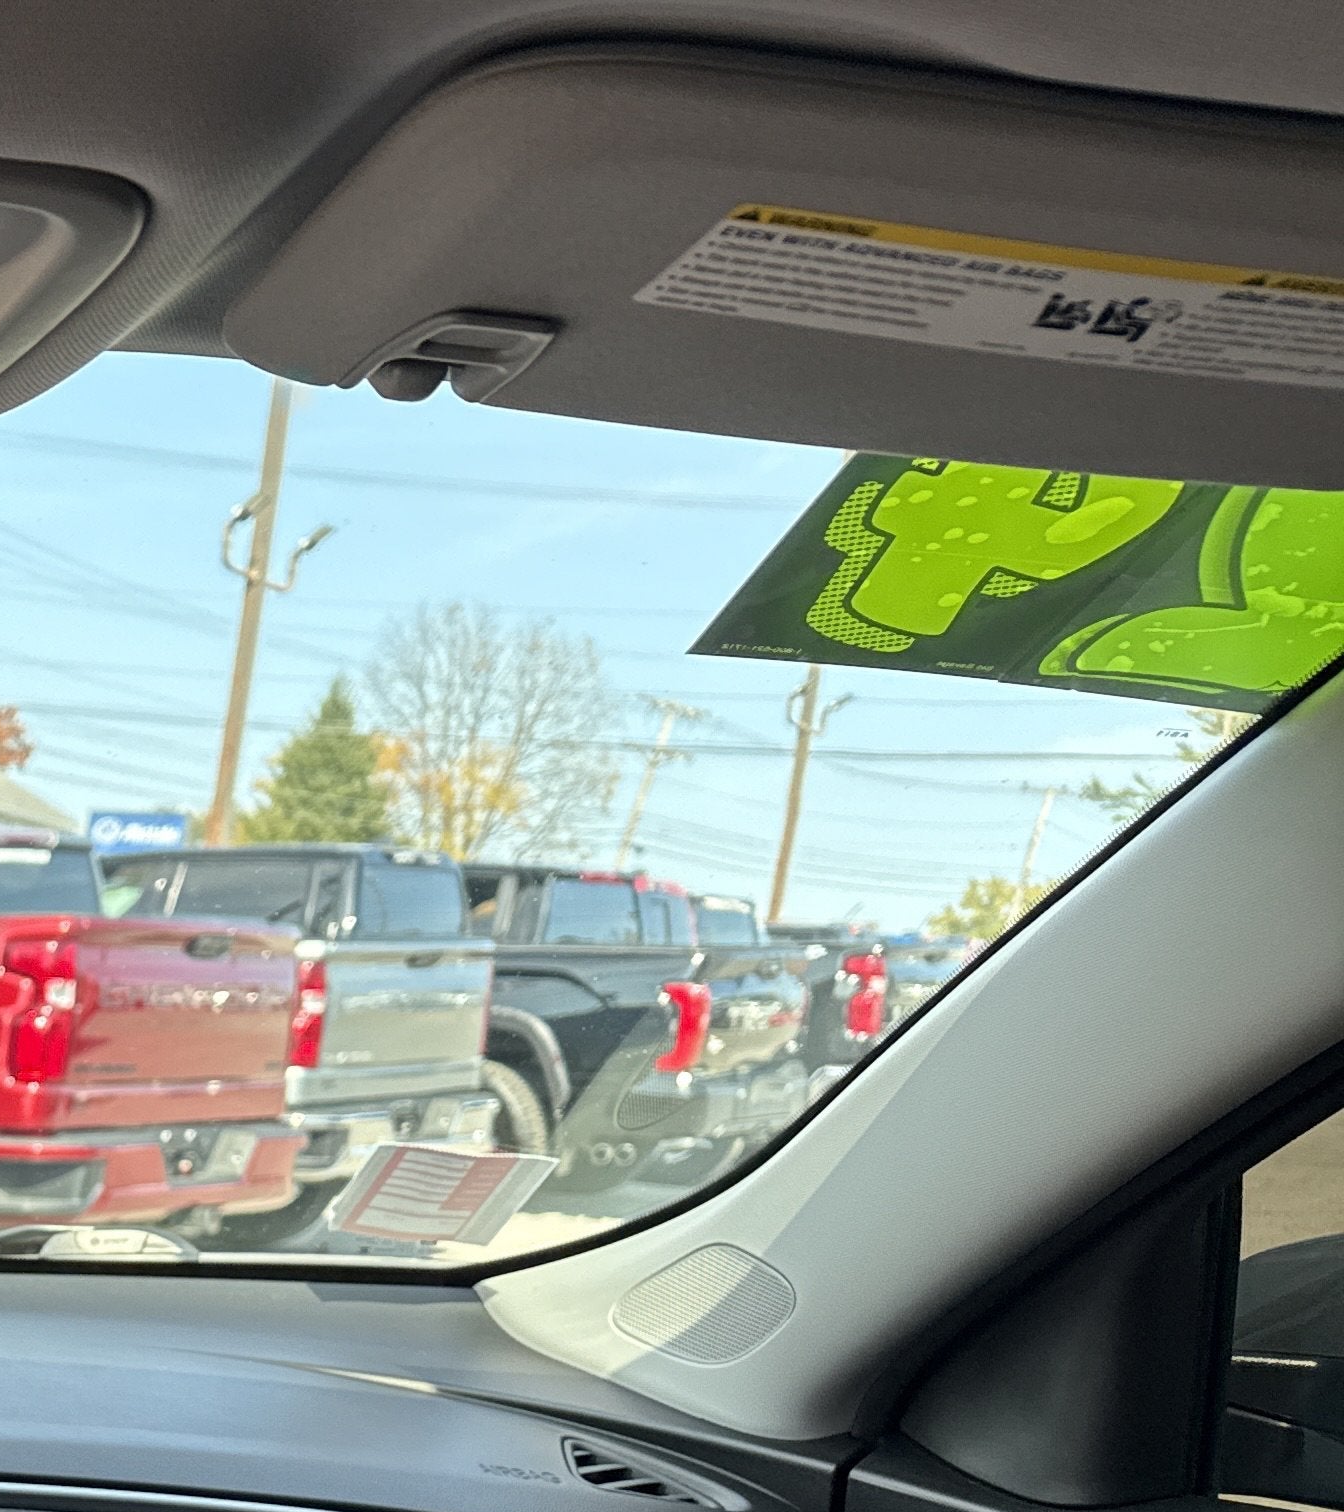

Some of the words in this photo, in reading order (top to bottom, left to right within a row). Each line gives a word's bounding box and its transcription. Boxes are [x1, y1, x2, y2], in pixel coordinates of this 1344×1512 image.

[720, 225, 780, 242] EVEN
[782, 234, 842, 250] WITH
[842, 242, 961, 268] ADVANCED
[962, 259, 1004, 274] AIR
[1004, 264, 1067, 281] BAGS
[479, 1463, 561, 1484] AIRBAG
